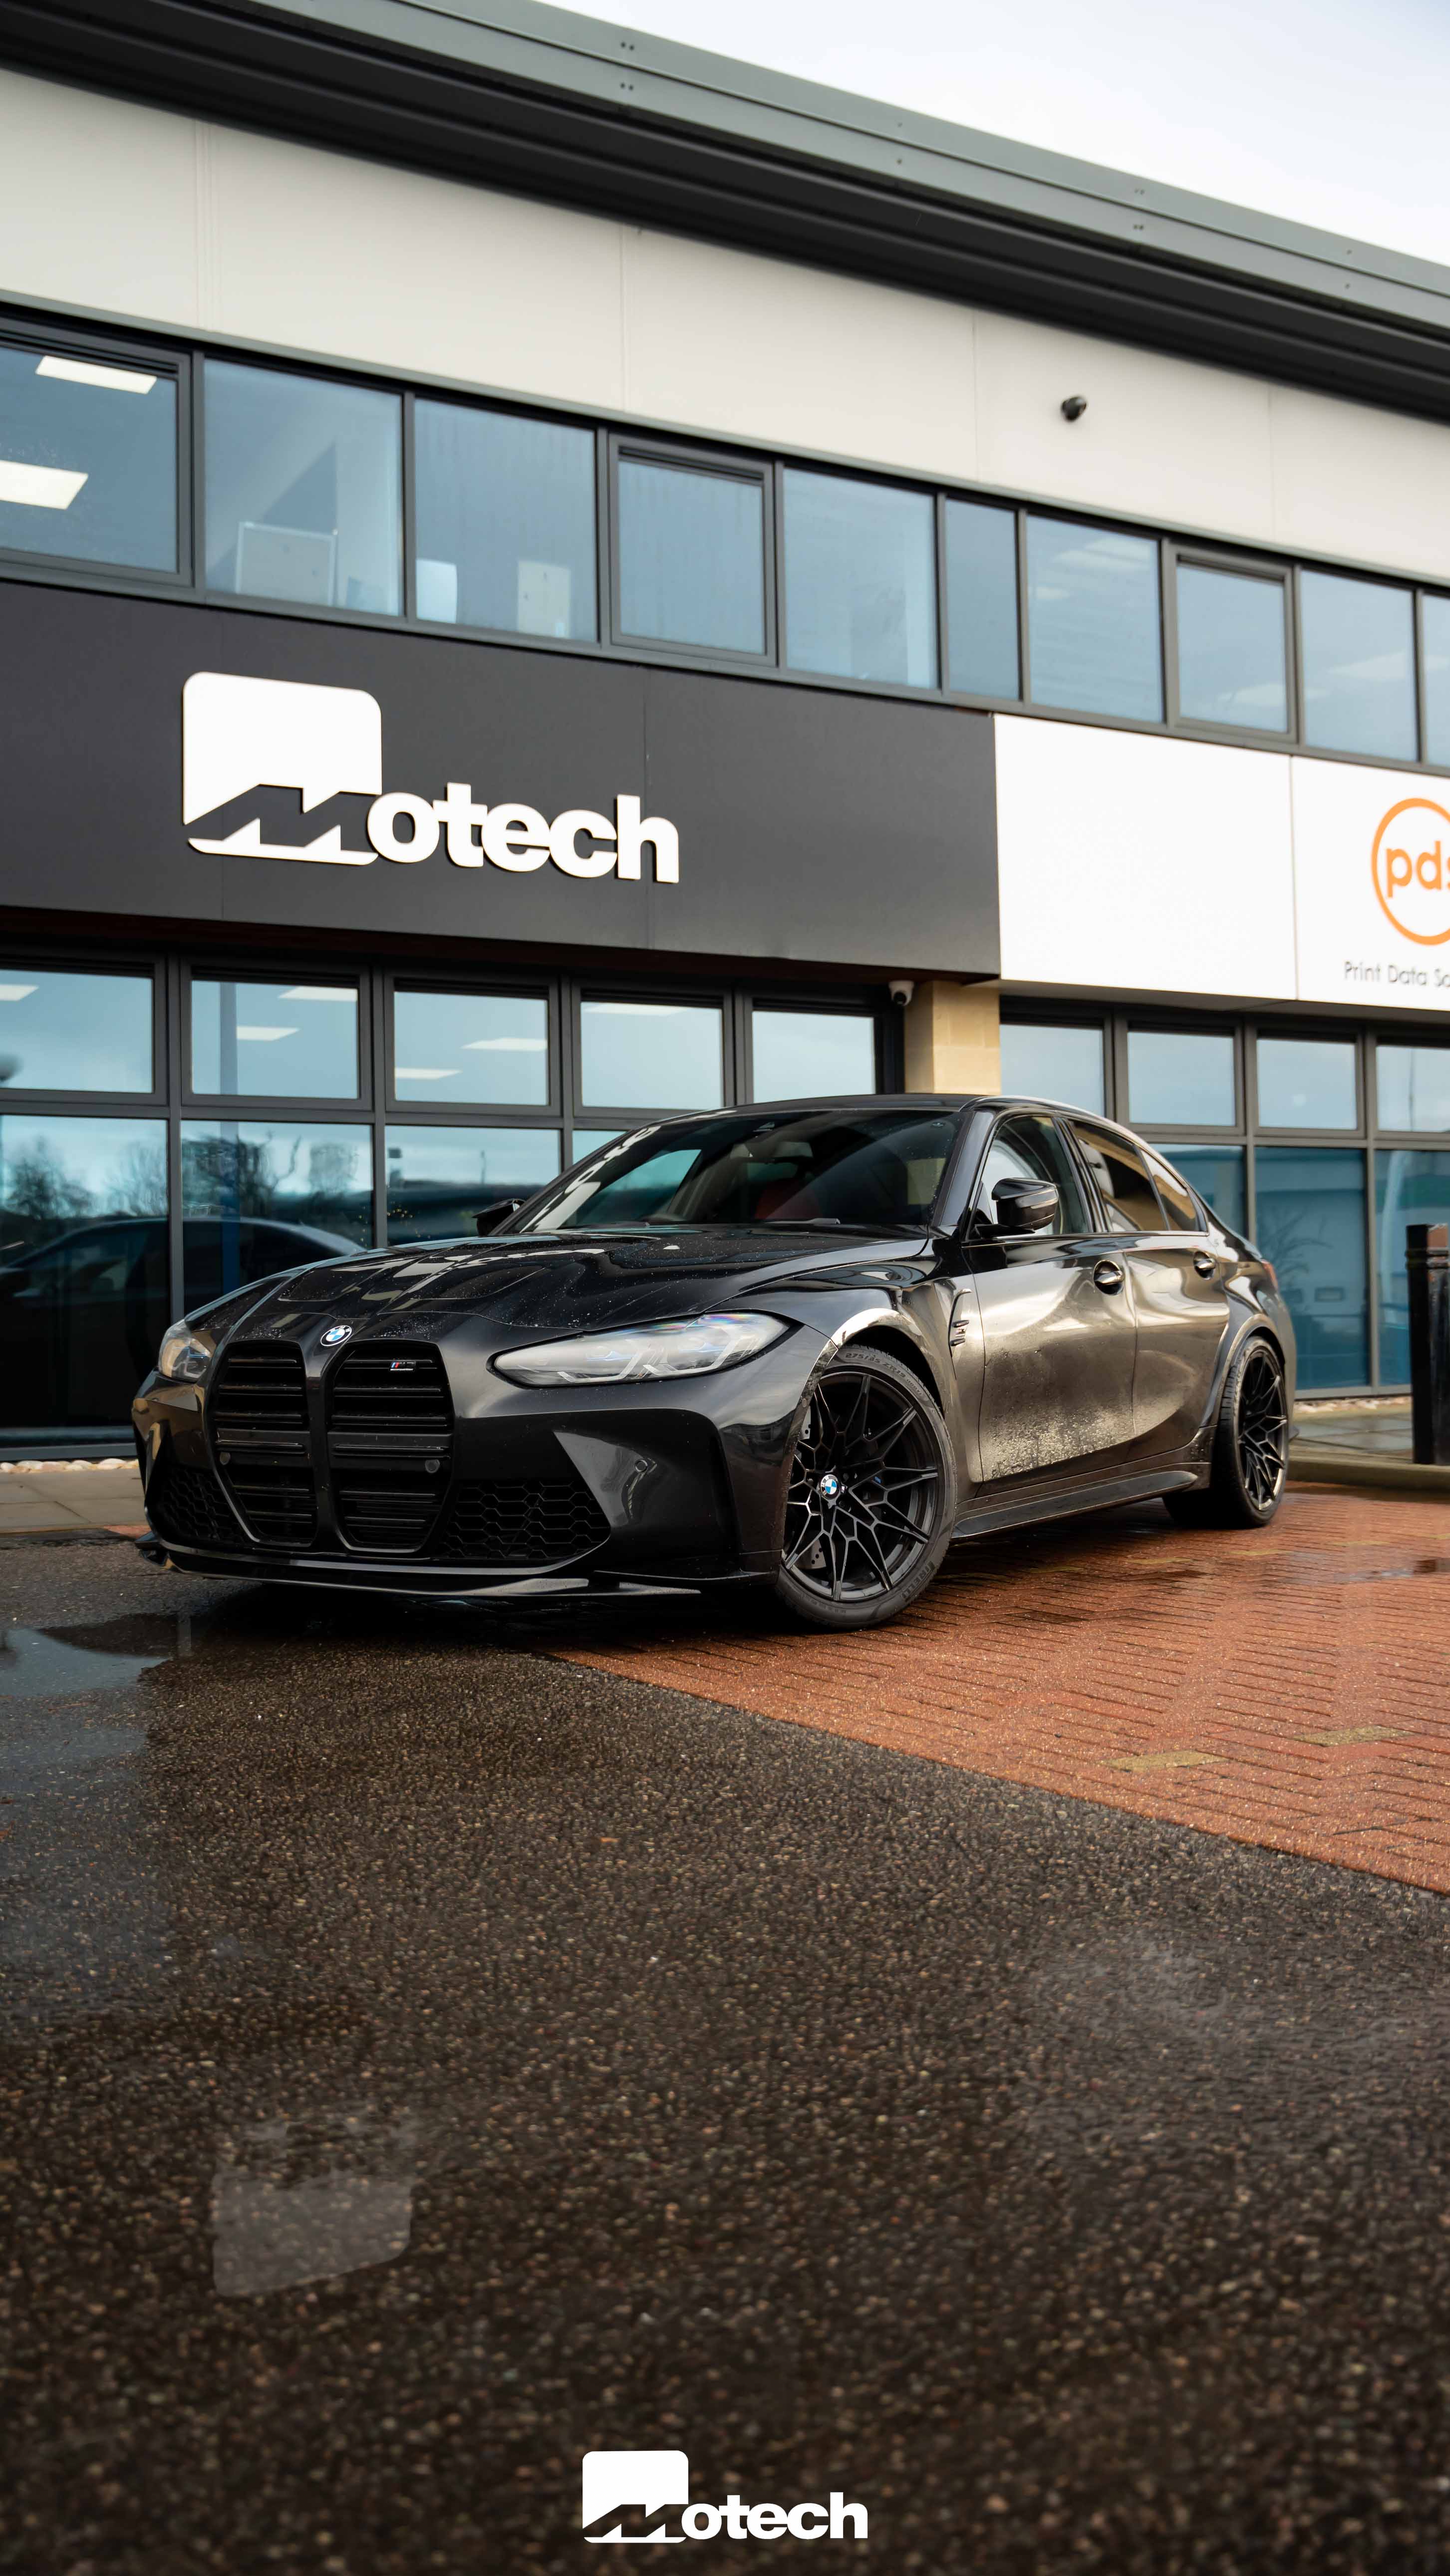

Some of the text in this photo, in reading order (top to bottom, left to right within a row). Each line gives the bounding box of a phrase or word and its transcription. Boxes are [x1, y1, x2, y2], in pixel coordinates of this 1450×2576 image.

[1386, 840, 1450, 898] pd
[1344, 960, 1381, 982] Print
[1388, 964, 1427, 986] Data
